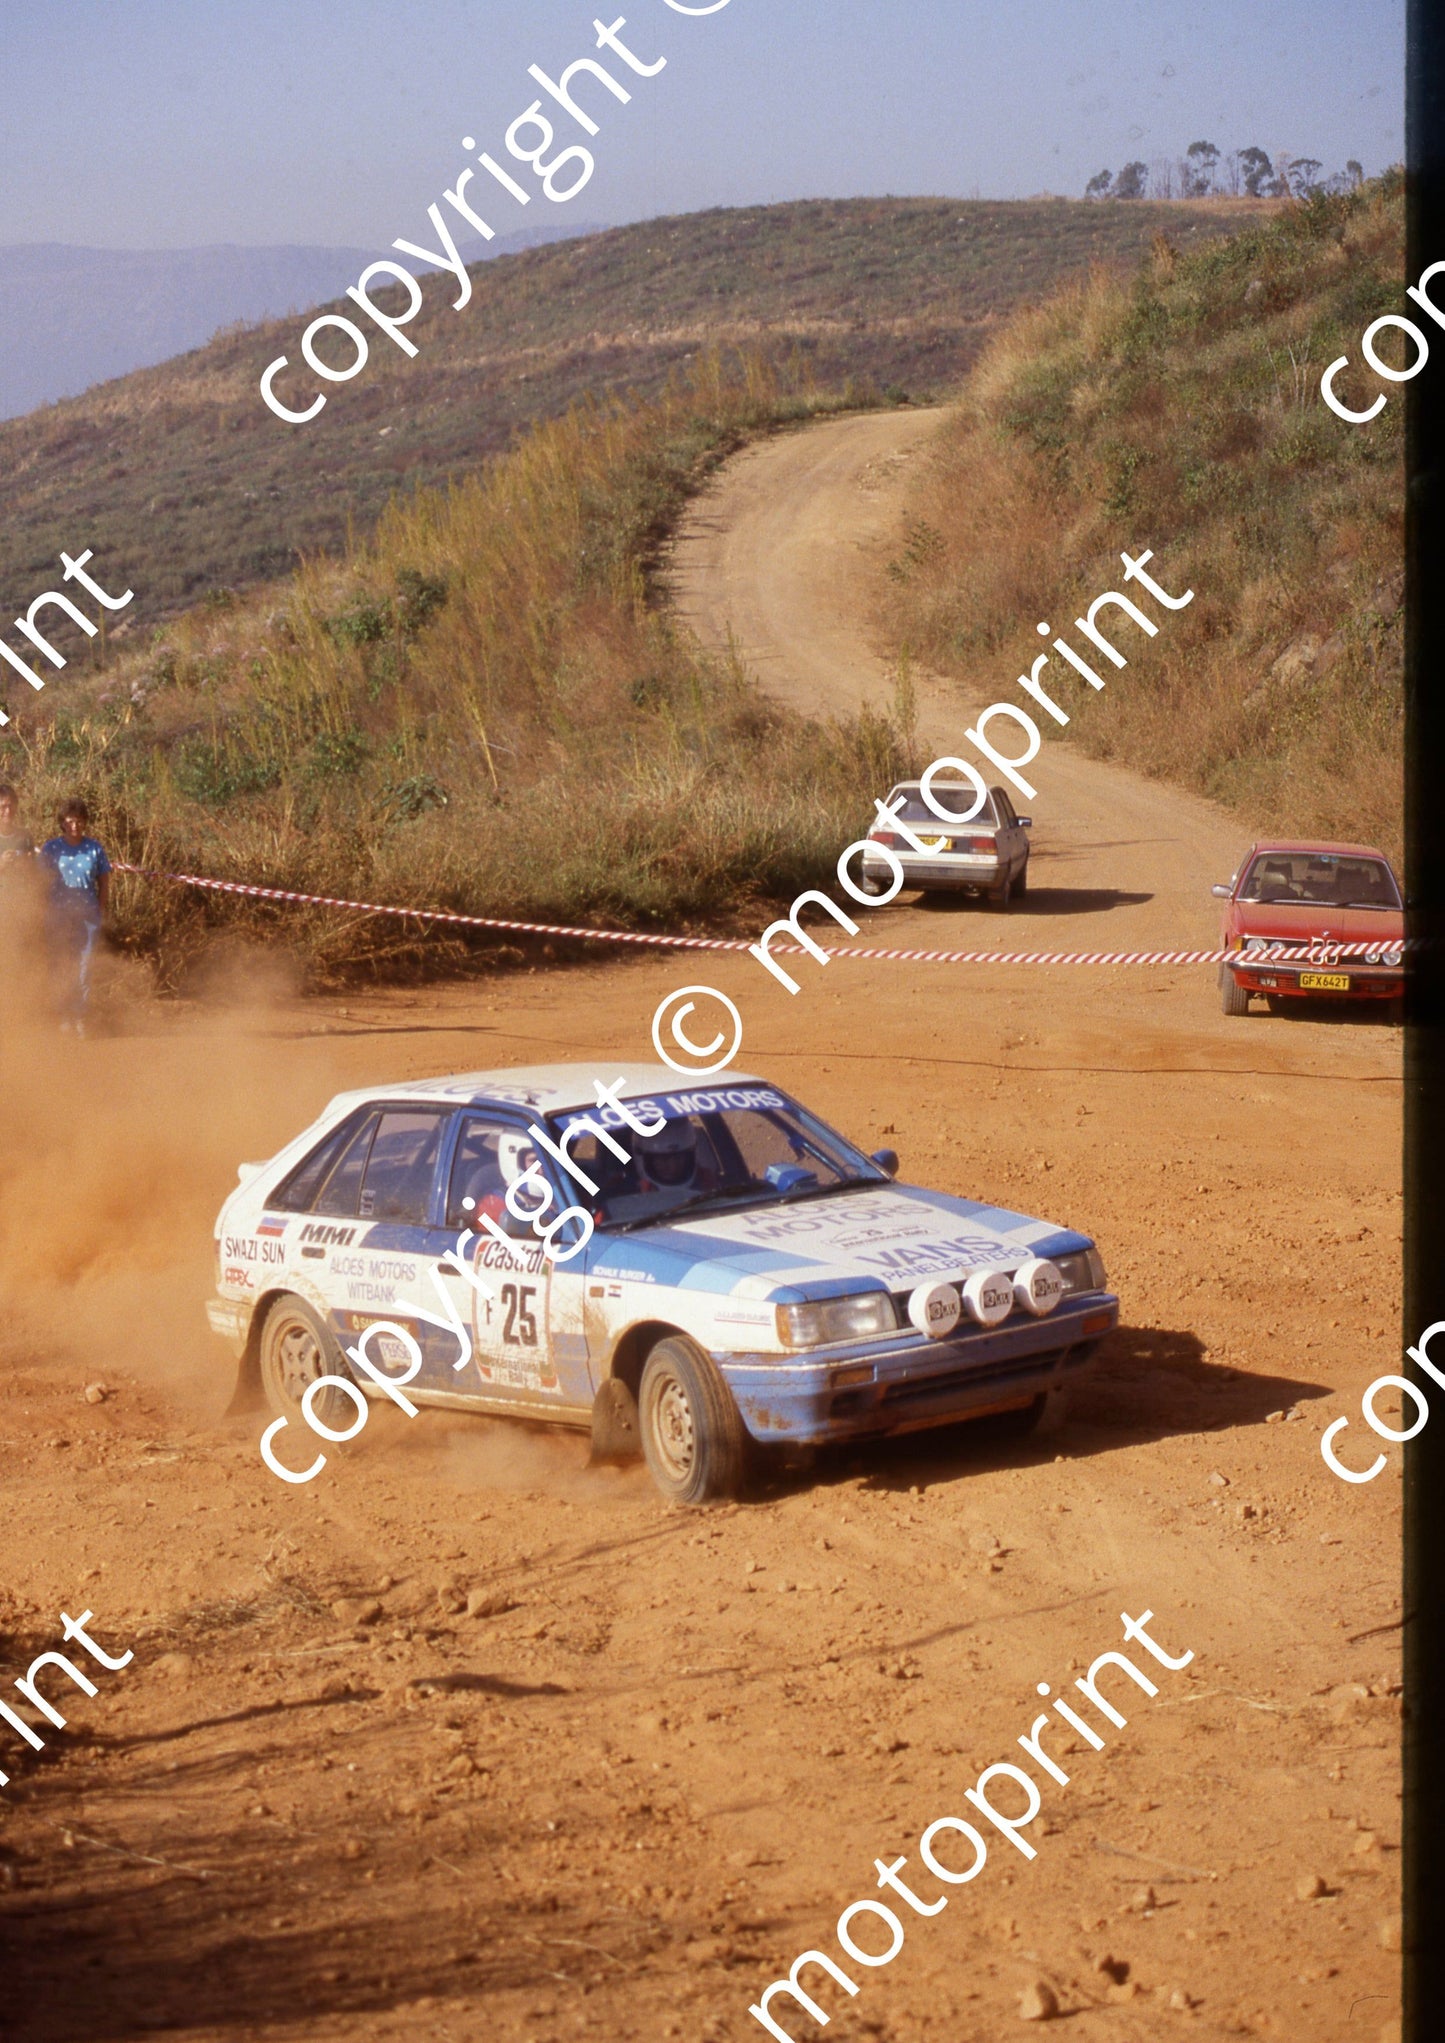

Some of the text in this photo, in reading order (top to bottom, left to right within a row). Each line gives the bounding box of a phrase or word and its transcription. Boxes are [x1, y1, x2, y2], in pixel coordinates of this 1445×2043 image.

[1302, 975, 1348, 988] GFX642T
[667, 1090, 784, 1115] MOTORS
[741, 1198, 881, 1225] ALOES
[744, 1203, 933, 1240] MOTORS
[298, 1223, 357, 1247] MMI
[225, 1236, 286, 1264] SWAZI SUN
[854, 1236, 1003, 1268] VANS
[330, 1257, 416, 1282] ALOES MOTORS
[880, 1247, 1028, 1281] PANELBEATERS
[347, 1281, 396, 1302] WITBANK
[501, 1283, 538, 1347] 25
